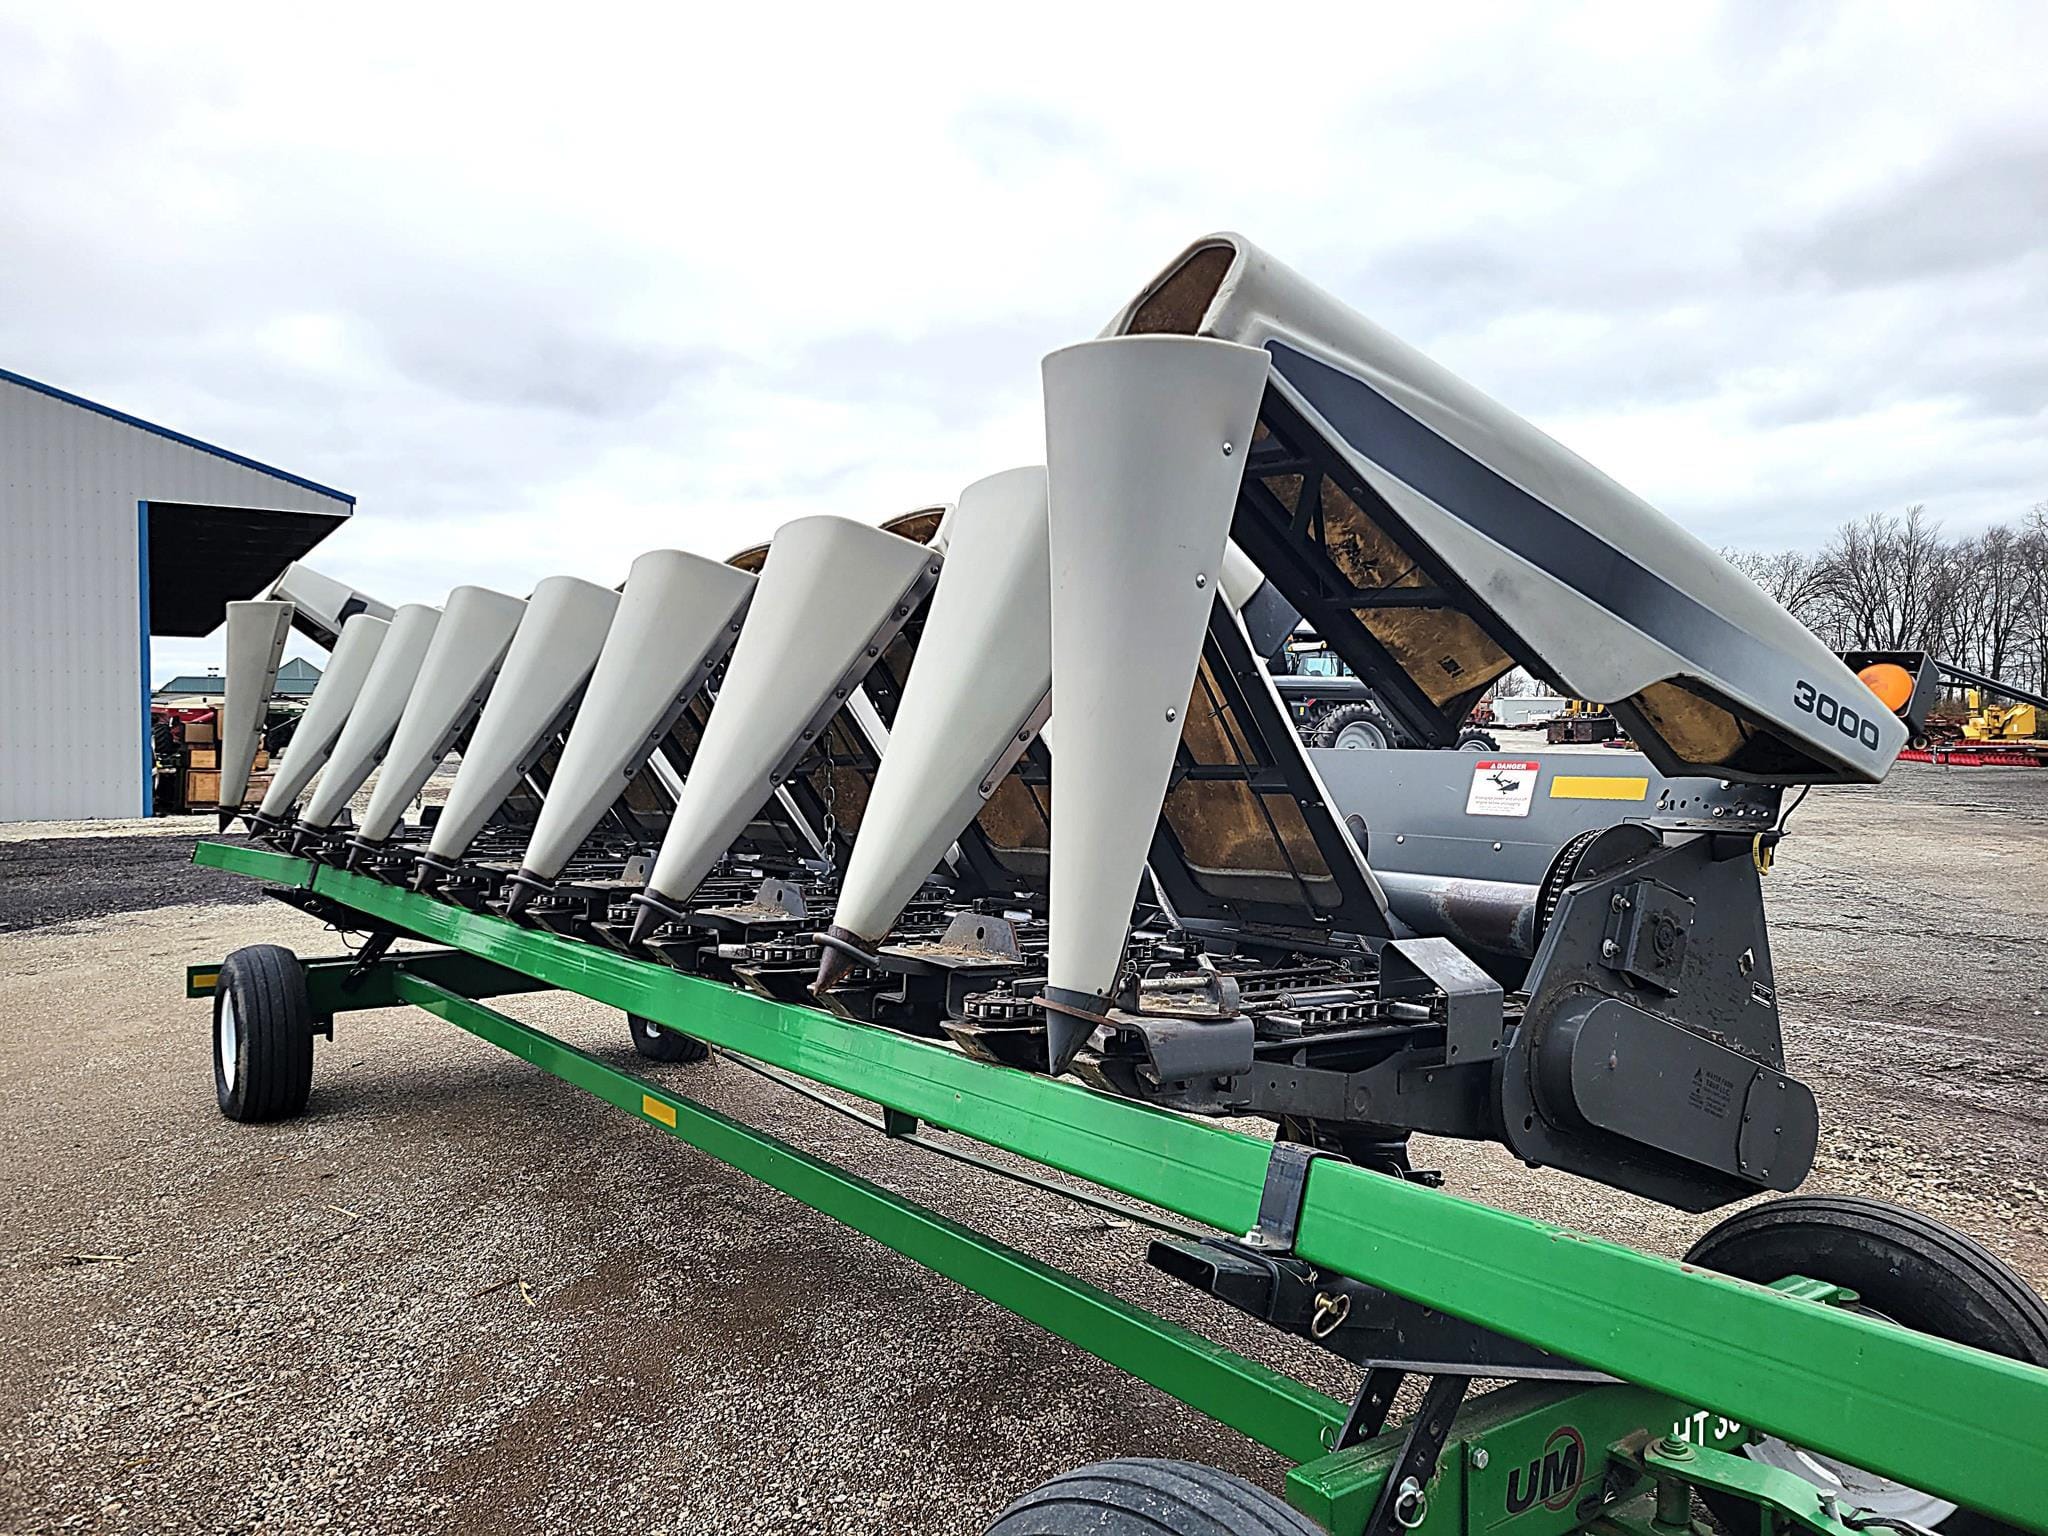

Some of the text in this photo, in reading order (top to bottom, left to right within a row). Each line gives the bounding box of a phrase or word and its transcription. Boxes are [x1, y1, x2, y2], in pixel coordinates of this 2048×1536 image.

[1793, 679, 1880, 751] 3000
[1673, 1410, 1710, 1447] HT
[1506, 1441, 1580, 1514] UM
